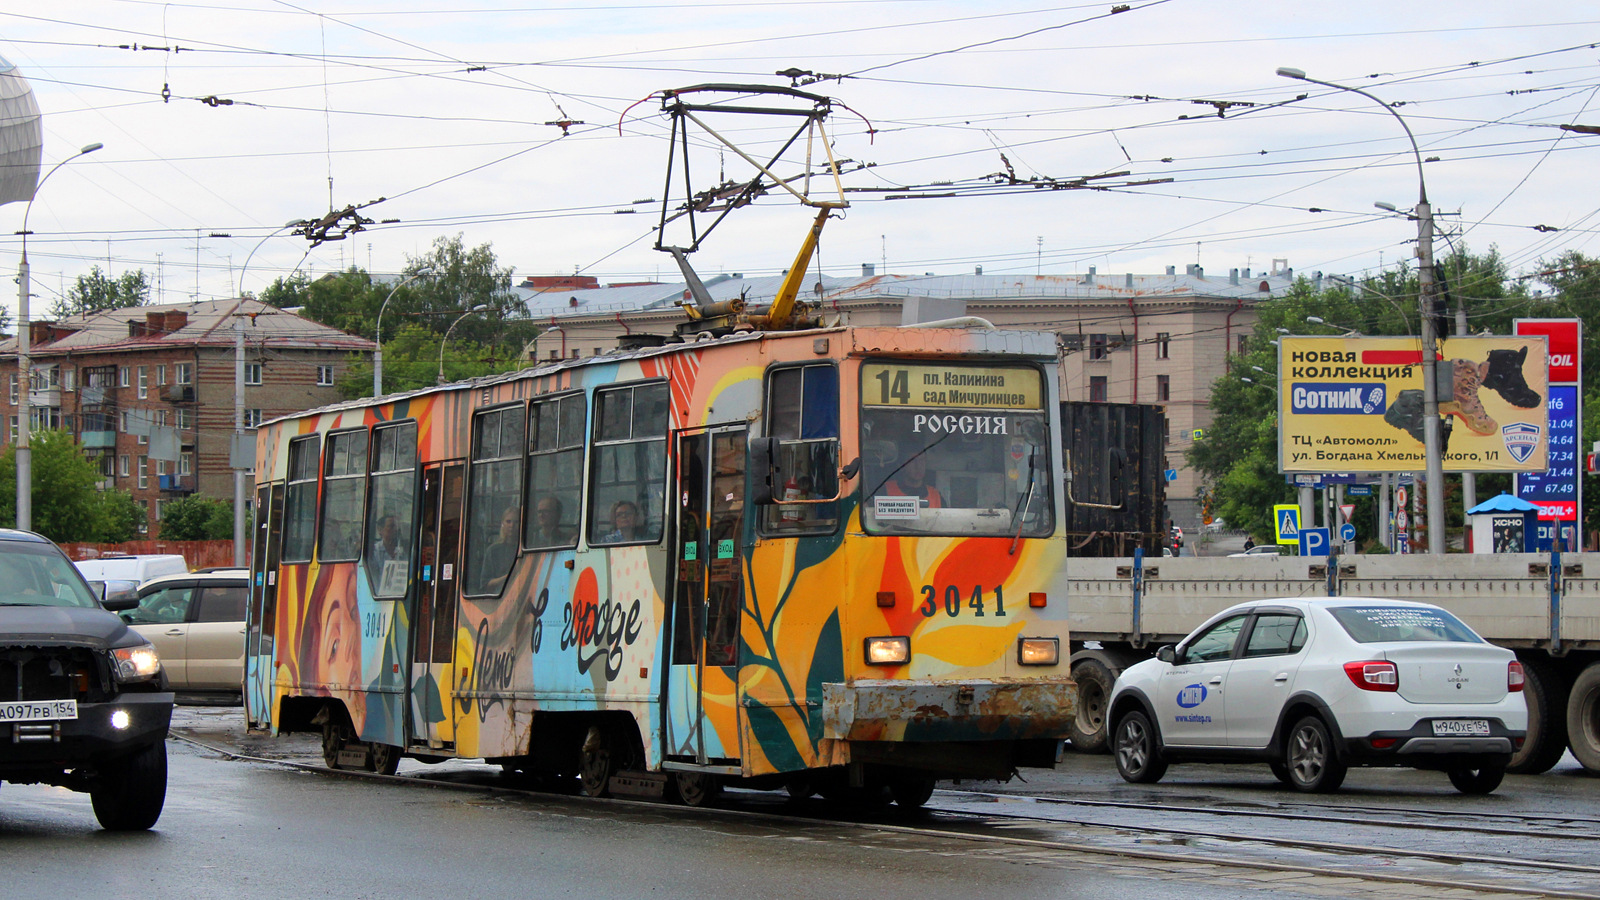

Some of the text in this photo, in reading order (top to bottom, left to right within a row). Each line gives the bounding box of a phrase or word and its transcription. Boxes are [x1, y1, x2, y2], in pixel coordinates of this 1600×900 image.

[1292, 351, 1357, 363] новая
[923, 372, 1005, 387] пл. Калинина
[1292, 366, 1413, 381] коллекция
[876, 369, 910, 404] 14
[923, 390, 1025, 405] сад Мичуринцев
[912, 414, 1008, 435] РОССИЯ
[1292, 435, 1398, 447] ТЦ «Автомолл»
[1505, 434, 1538, 443] АРСЕНАЛ
[1292, 452, 1312, 463] ул.
[1316, 450, 1373, 462] Богдана
[1485, 451, 1499, 460] 1/1
[1522, 484, 1574, 493] ДТ 67.49
[1494, 519, 1523, 527] XCHO
[718, 544, 733, 553] ВХОД
[919, 584, 1006, 618] 3041
[365, 612, 387, 639] 3041
[560, 598, 643, 682] городе
[53, 702, 74, 714] 154
[1174, 714, 1212, 724] www.sintep.ru
[1473, 721, 1488, 730] 154
